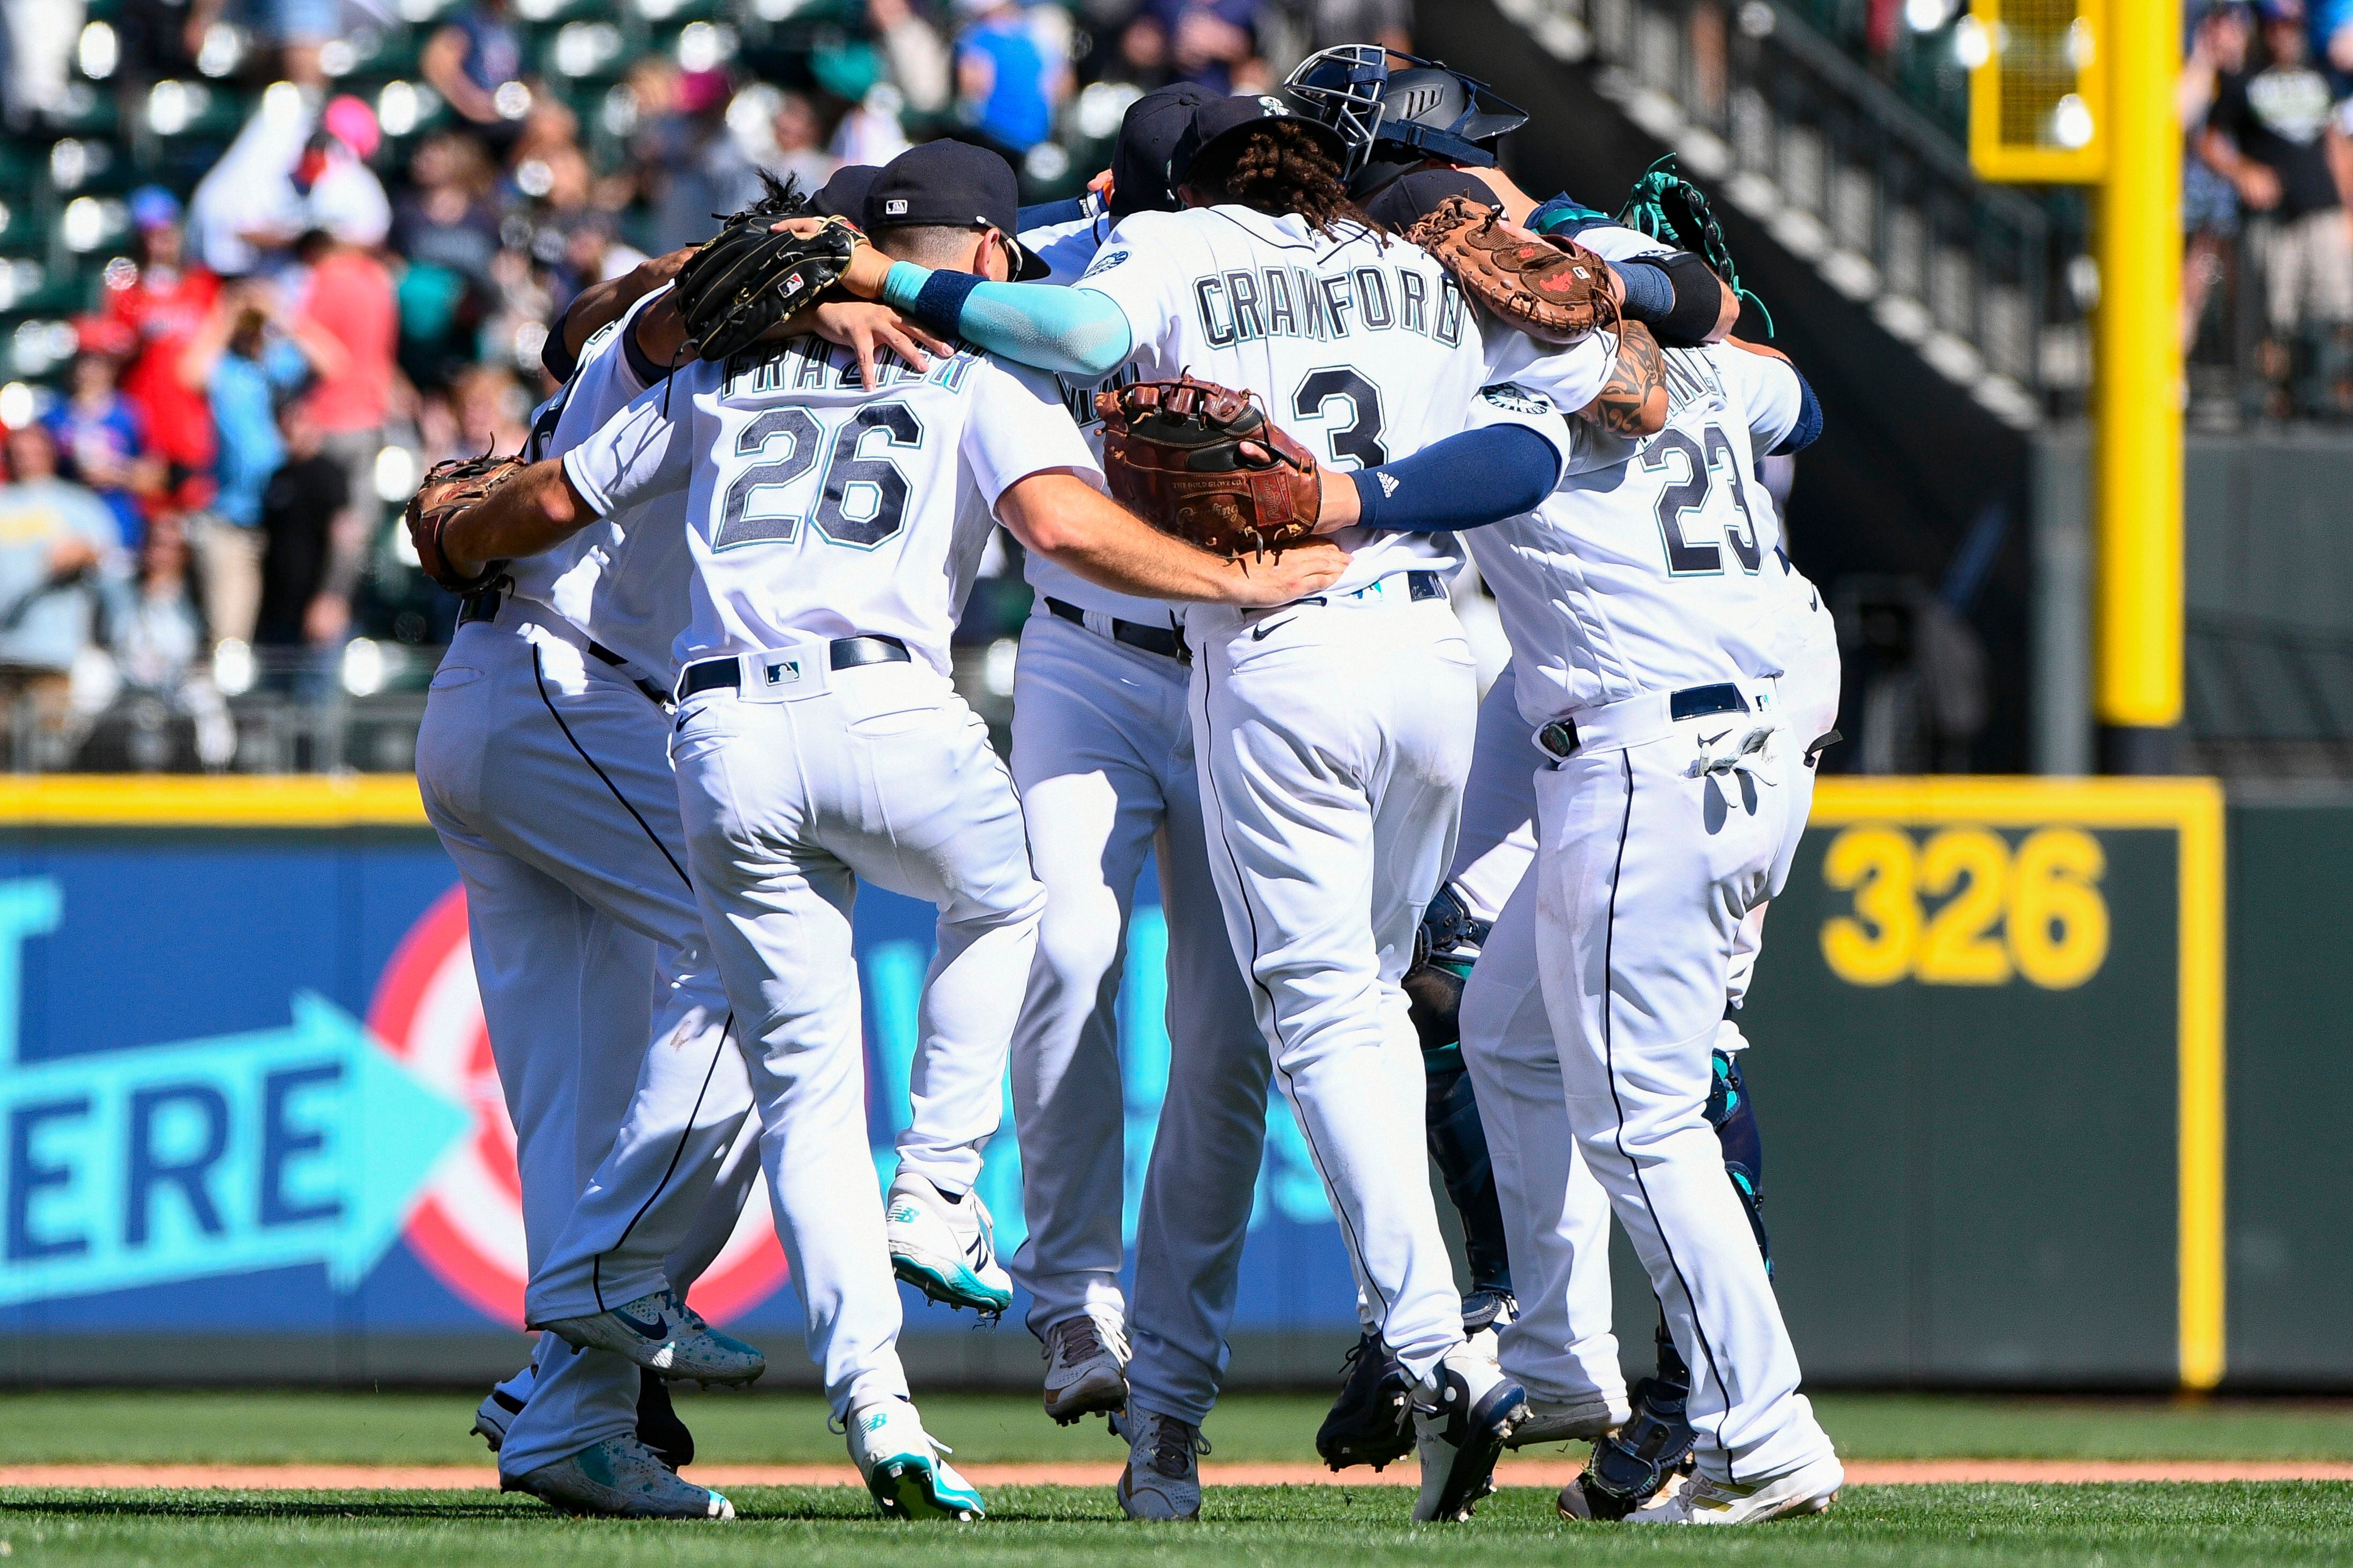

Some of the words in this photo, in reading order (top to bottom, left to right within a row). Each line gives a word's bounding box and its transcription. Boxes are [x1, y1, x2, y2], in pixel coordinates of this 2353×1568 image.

[1193, 265, 1468, 350] CRAWFORD
[712, 400, 924, 552] 26
[1291, 364, 1389, 471] 3
[1175, 503, 1239, 524] Rling
[1376, 471, 1392, 498] adidas
[1633, 422, 1763, 577] 23
[1820, 828, 2110, 987] 326
[5, 1061, 344, 1260] ERE
